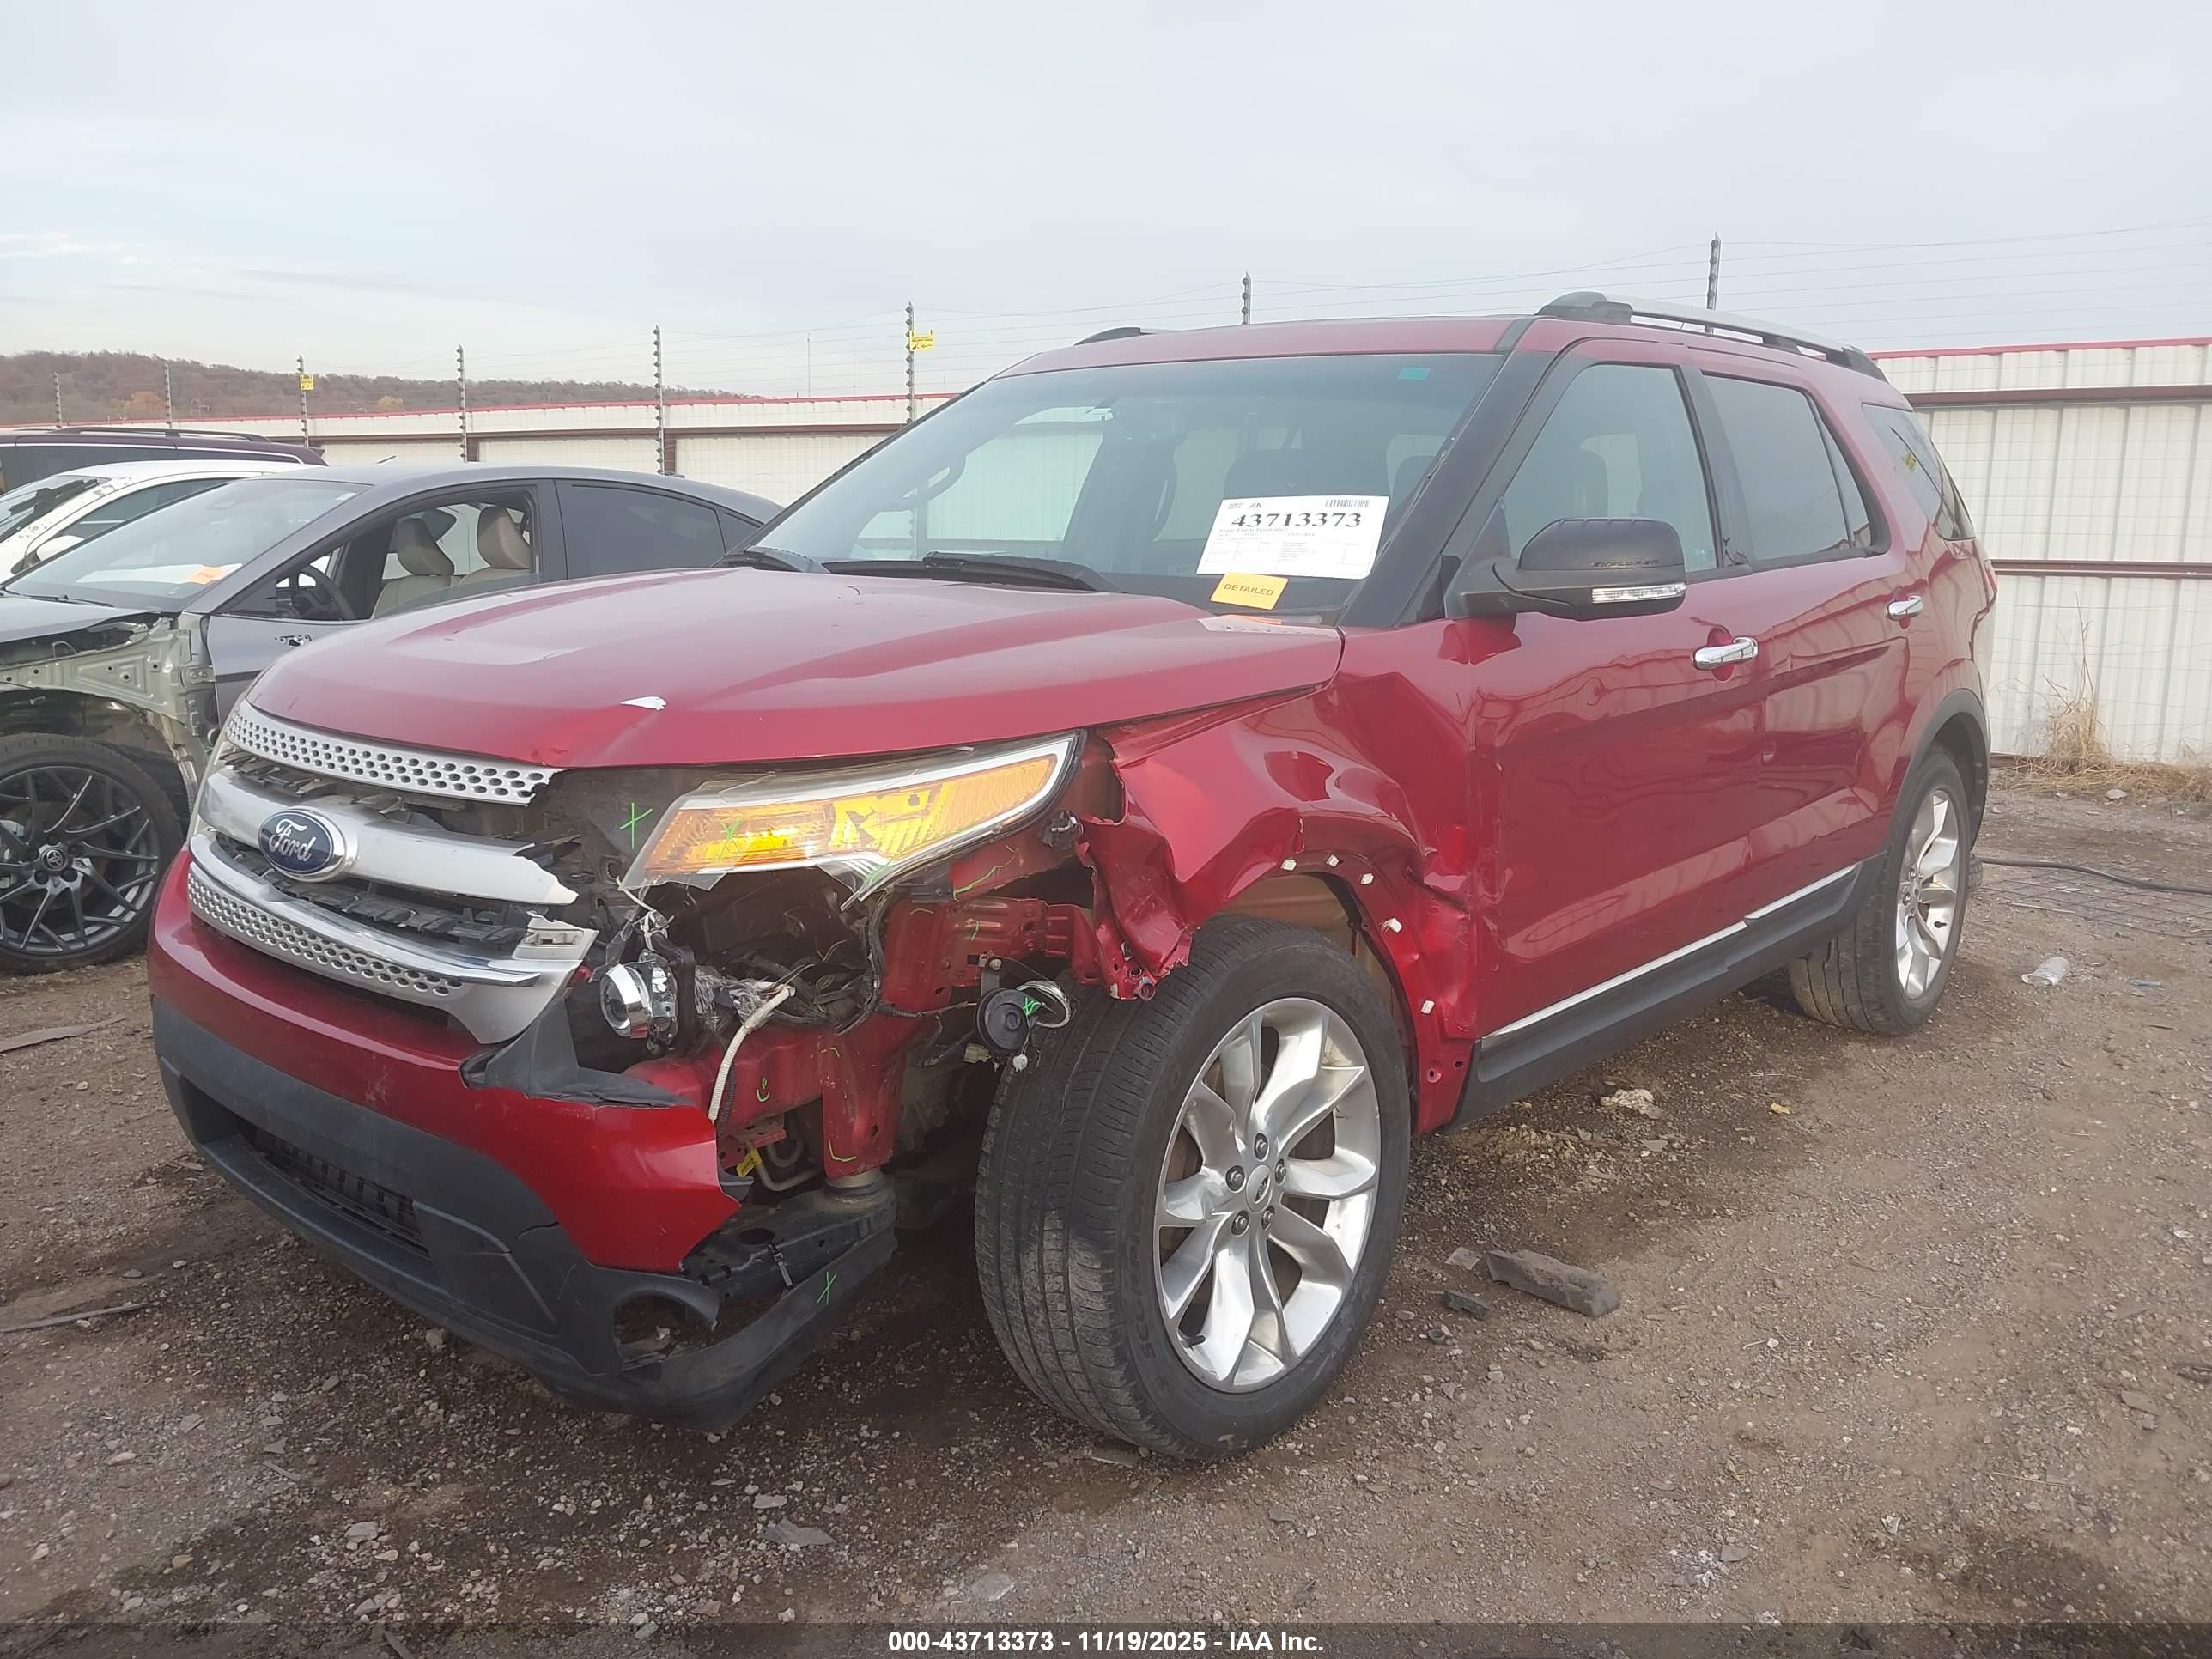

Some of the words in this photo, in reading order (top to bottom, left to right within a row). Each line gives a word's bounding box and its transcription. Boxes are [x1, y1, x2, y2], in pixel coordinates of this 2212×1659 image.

[1231, 512, 1362, 528] 43713373
[1224, 582, 1274, 597] DETAILED
[268, 818, 317, 862] Ford
